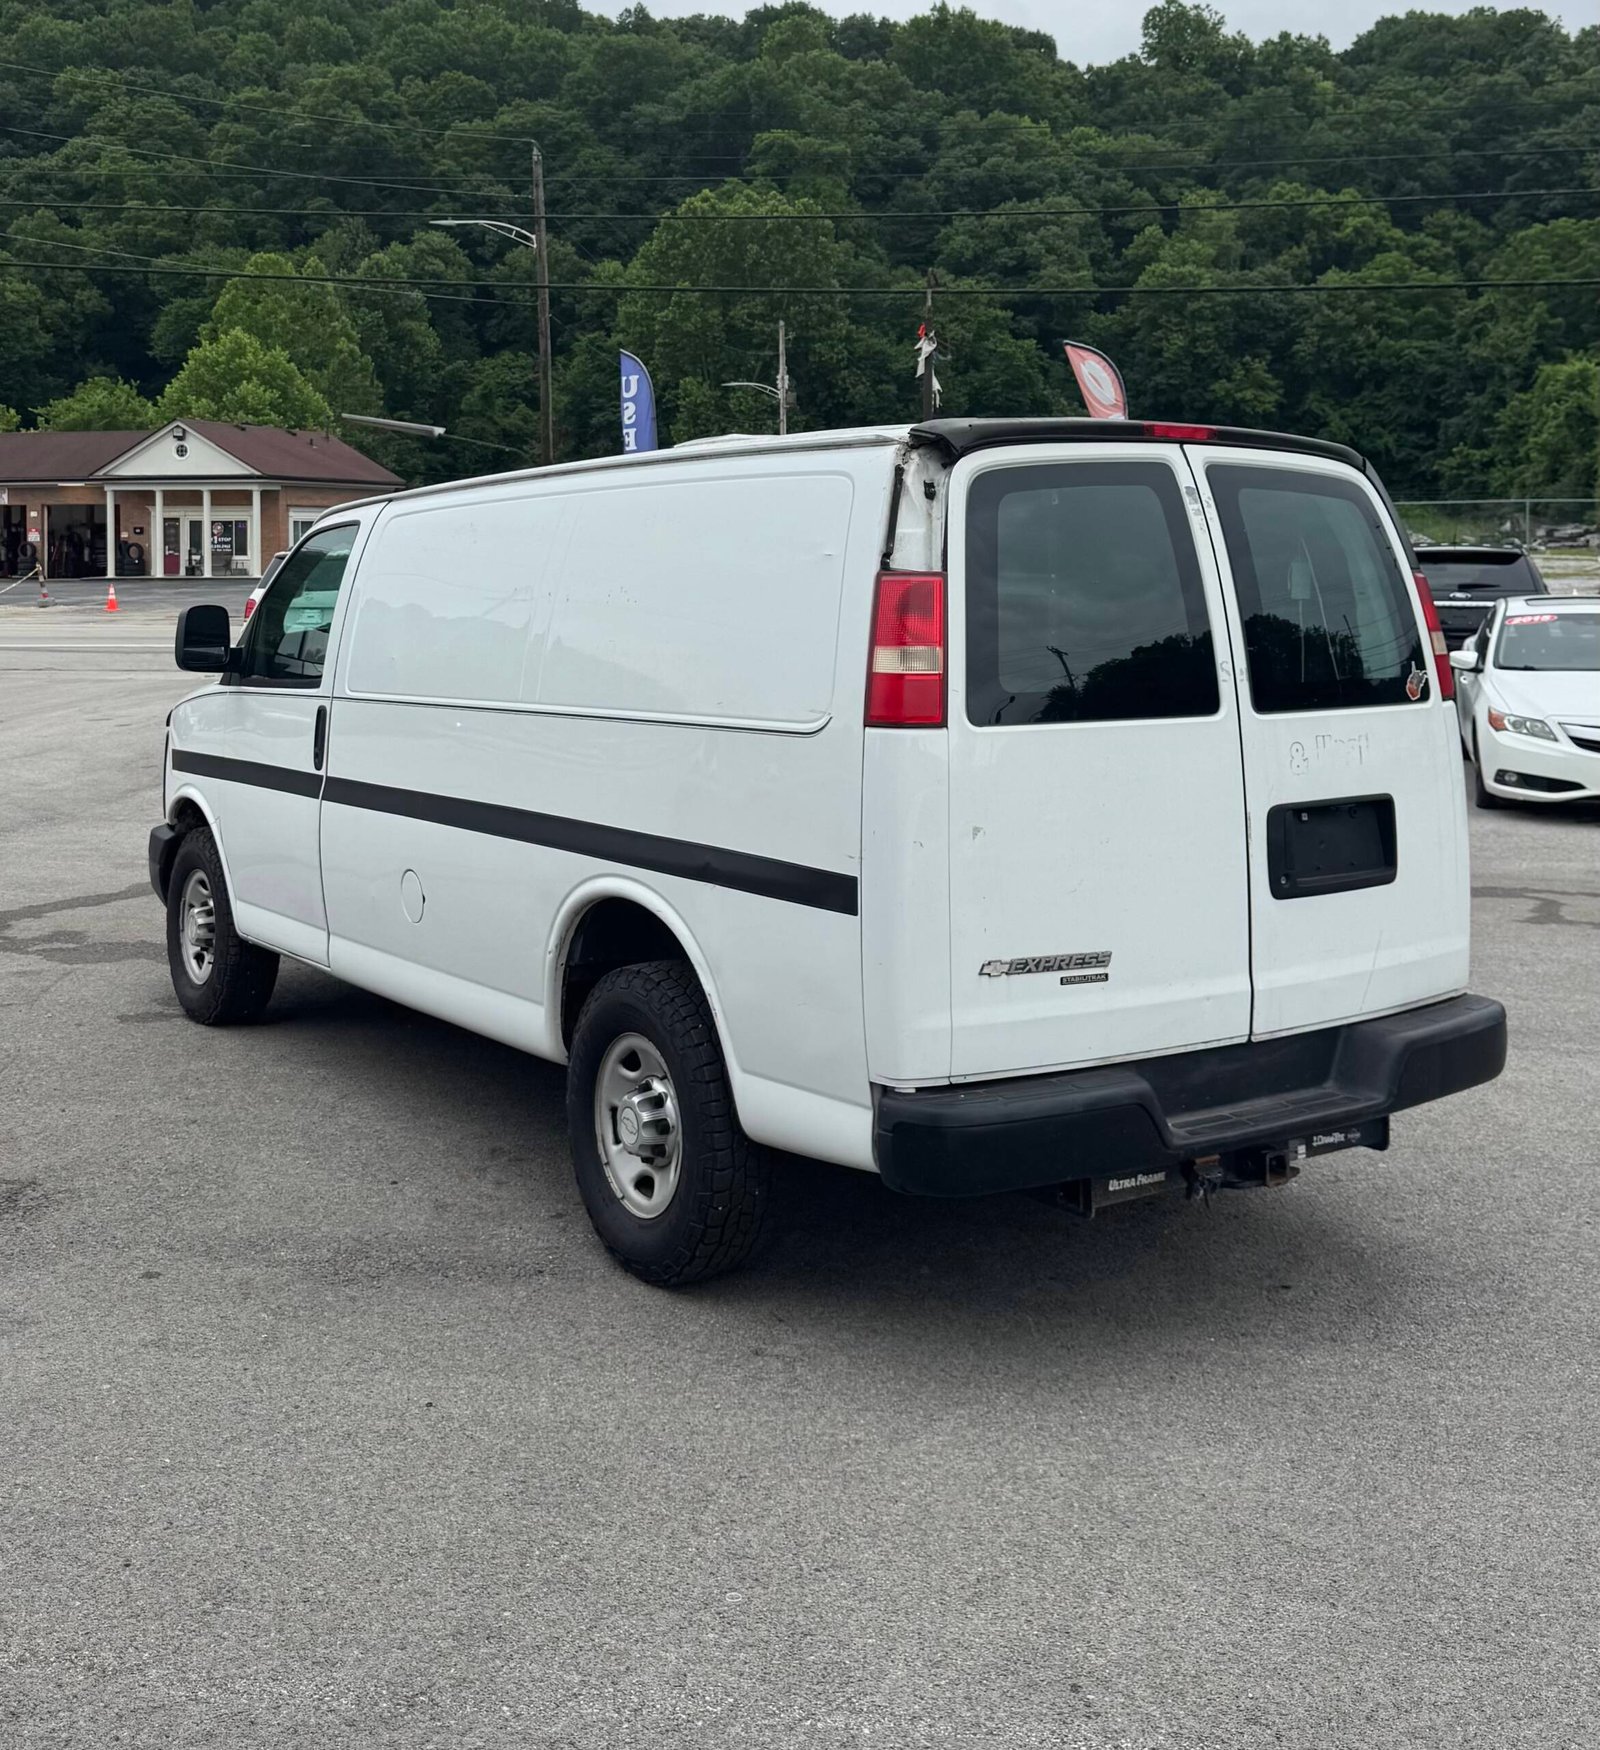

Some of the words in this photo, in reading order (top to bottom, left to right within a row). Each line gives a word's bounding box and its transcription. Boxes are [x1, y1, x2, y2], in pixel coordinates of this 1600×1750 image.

[1007, 951, 1112, 975] EXPRESS
[1062, 974, 1107, 985] STABILITRAK
[1108, 1178, 1136, 1191] ULTRA
